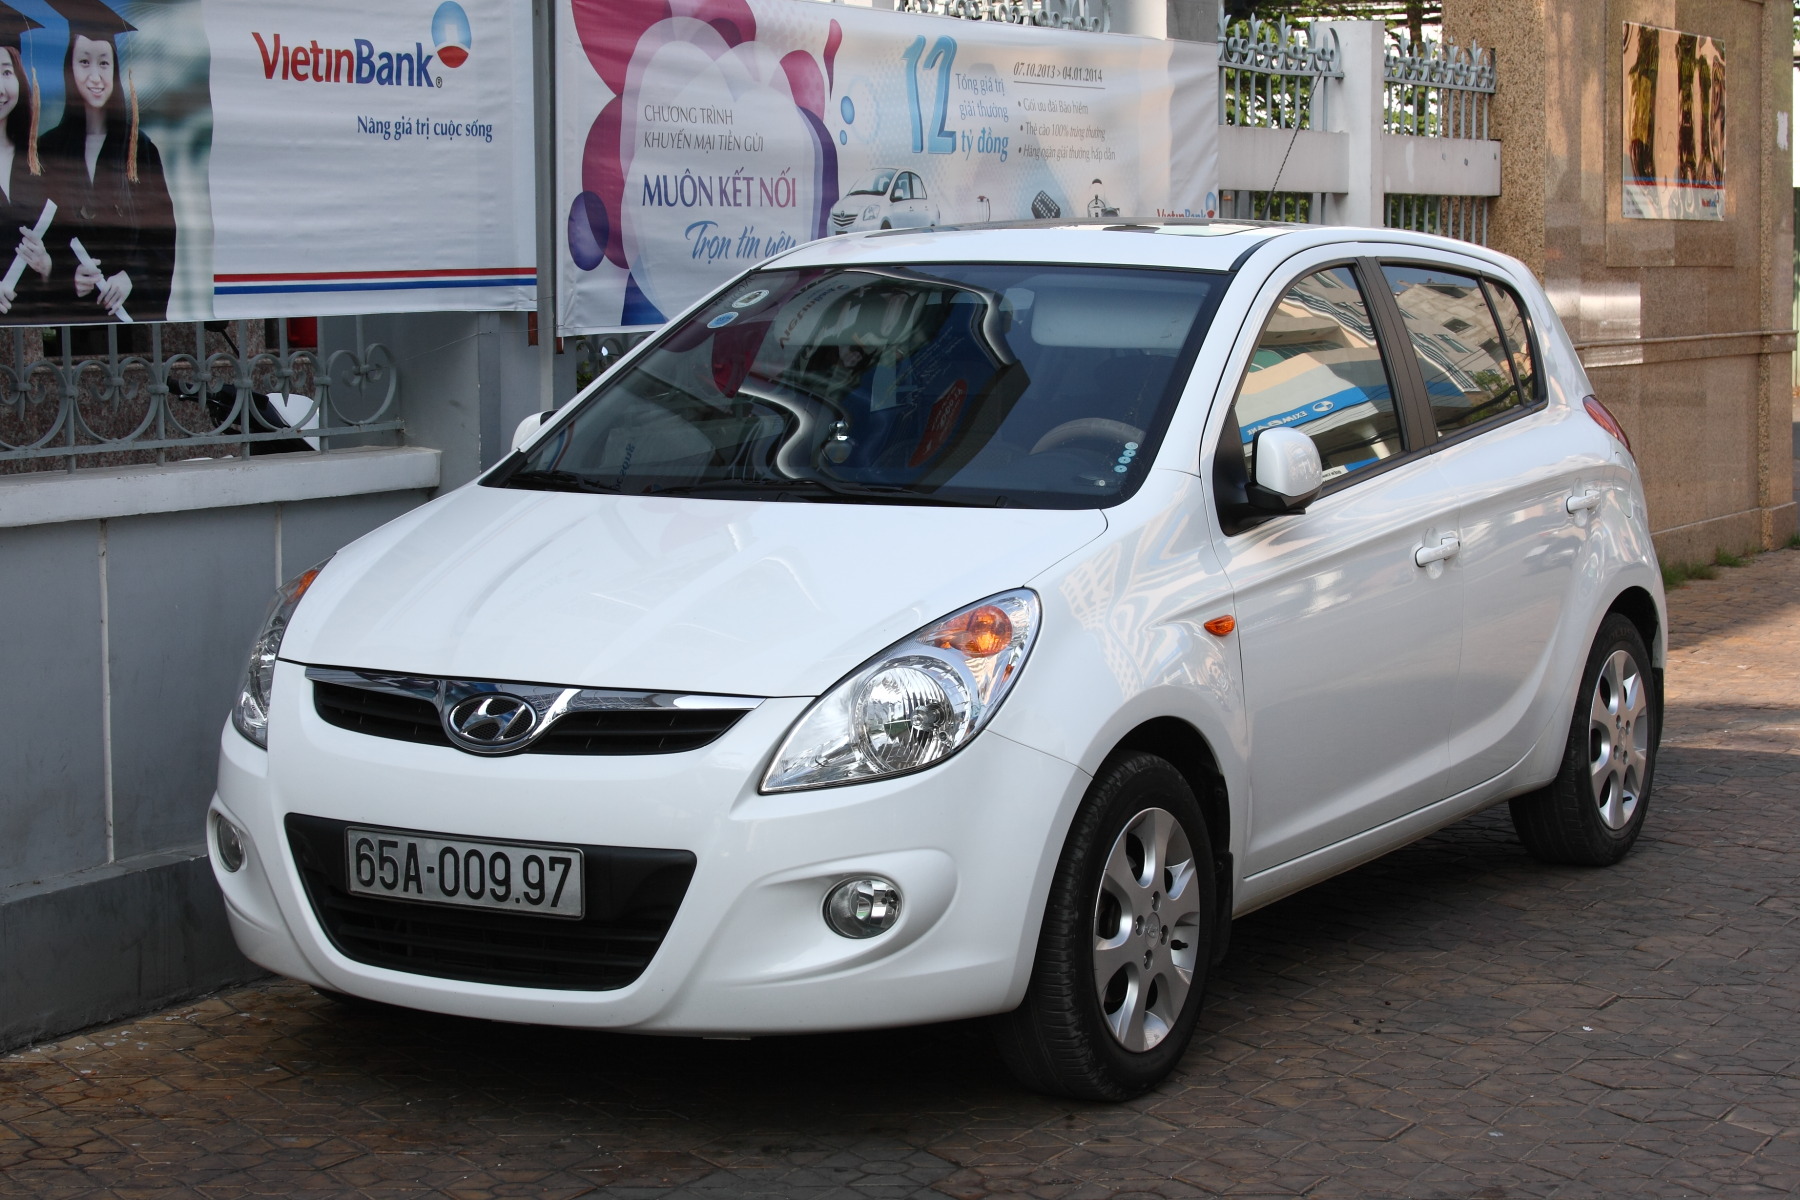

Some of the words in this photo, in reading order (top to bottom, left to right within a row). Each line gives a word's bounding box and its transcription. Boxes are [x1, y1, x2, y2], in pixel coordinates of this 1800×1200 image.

[251, 32, 435, 88] VietinBank
[1013, 62, 1056, 79] 07.10.2013
[1062, 66, 1103, 83] 04.01.2014
[901, 35, 958, 154] 12
[955, 73, 979, 95] Tổng
[980, 76, 993, 96] giá
[994, 78, 1005, 96] trị
[644, 104, 697, 123] CHƯƠNG
[700, 105, 733, 125] TRÌNH
[959, 100, 976, 120] giải
[977, 100, 1009, 122] thưởng
[357, 115, 391, 141] Nâng
[394, 116, 412, 141] giá
[416, 117, 430, 140] trị
[433, 120, 462, 141] cuộc
[465, 119, 493, 143] sống
[644, 129, 692, 149] KHUYẾN
[694, 134, 716, 154] MẠI
[744, 132, 764, 152] GỬI
[1038, 123, 1050, 136] cào
[1052, 124, 1068, 137] 100%
[961, 129, 974, 161] tỷ
[977, 127, 1009, 163] đồng
[642, 168, 713, 207] MUÔN
[718, 166, 754, 207] KẾT
[760, 166, 796, 208] NỐI
[685, 220, 733, 265] Trọn
[736, 225, 761, 260] tín
[355, 837, 573, 908] 65A-009.97
